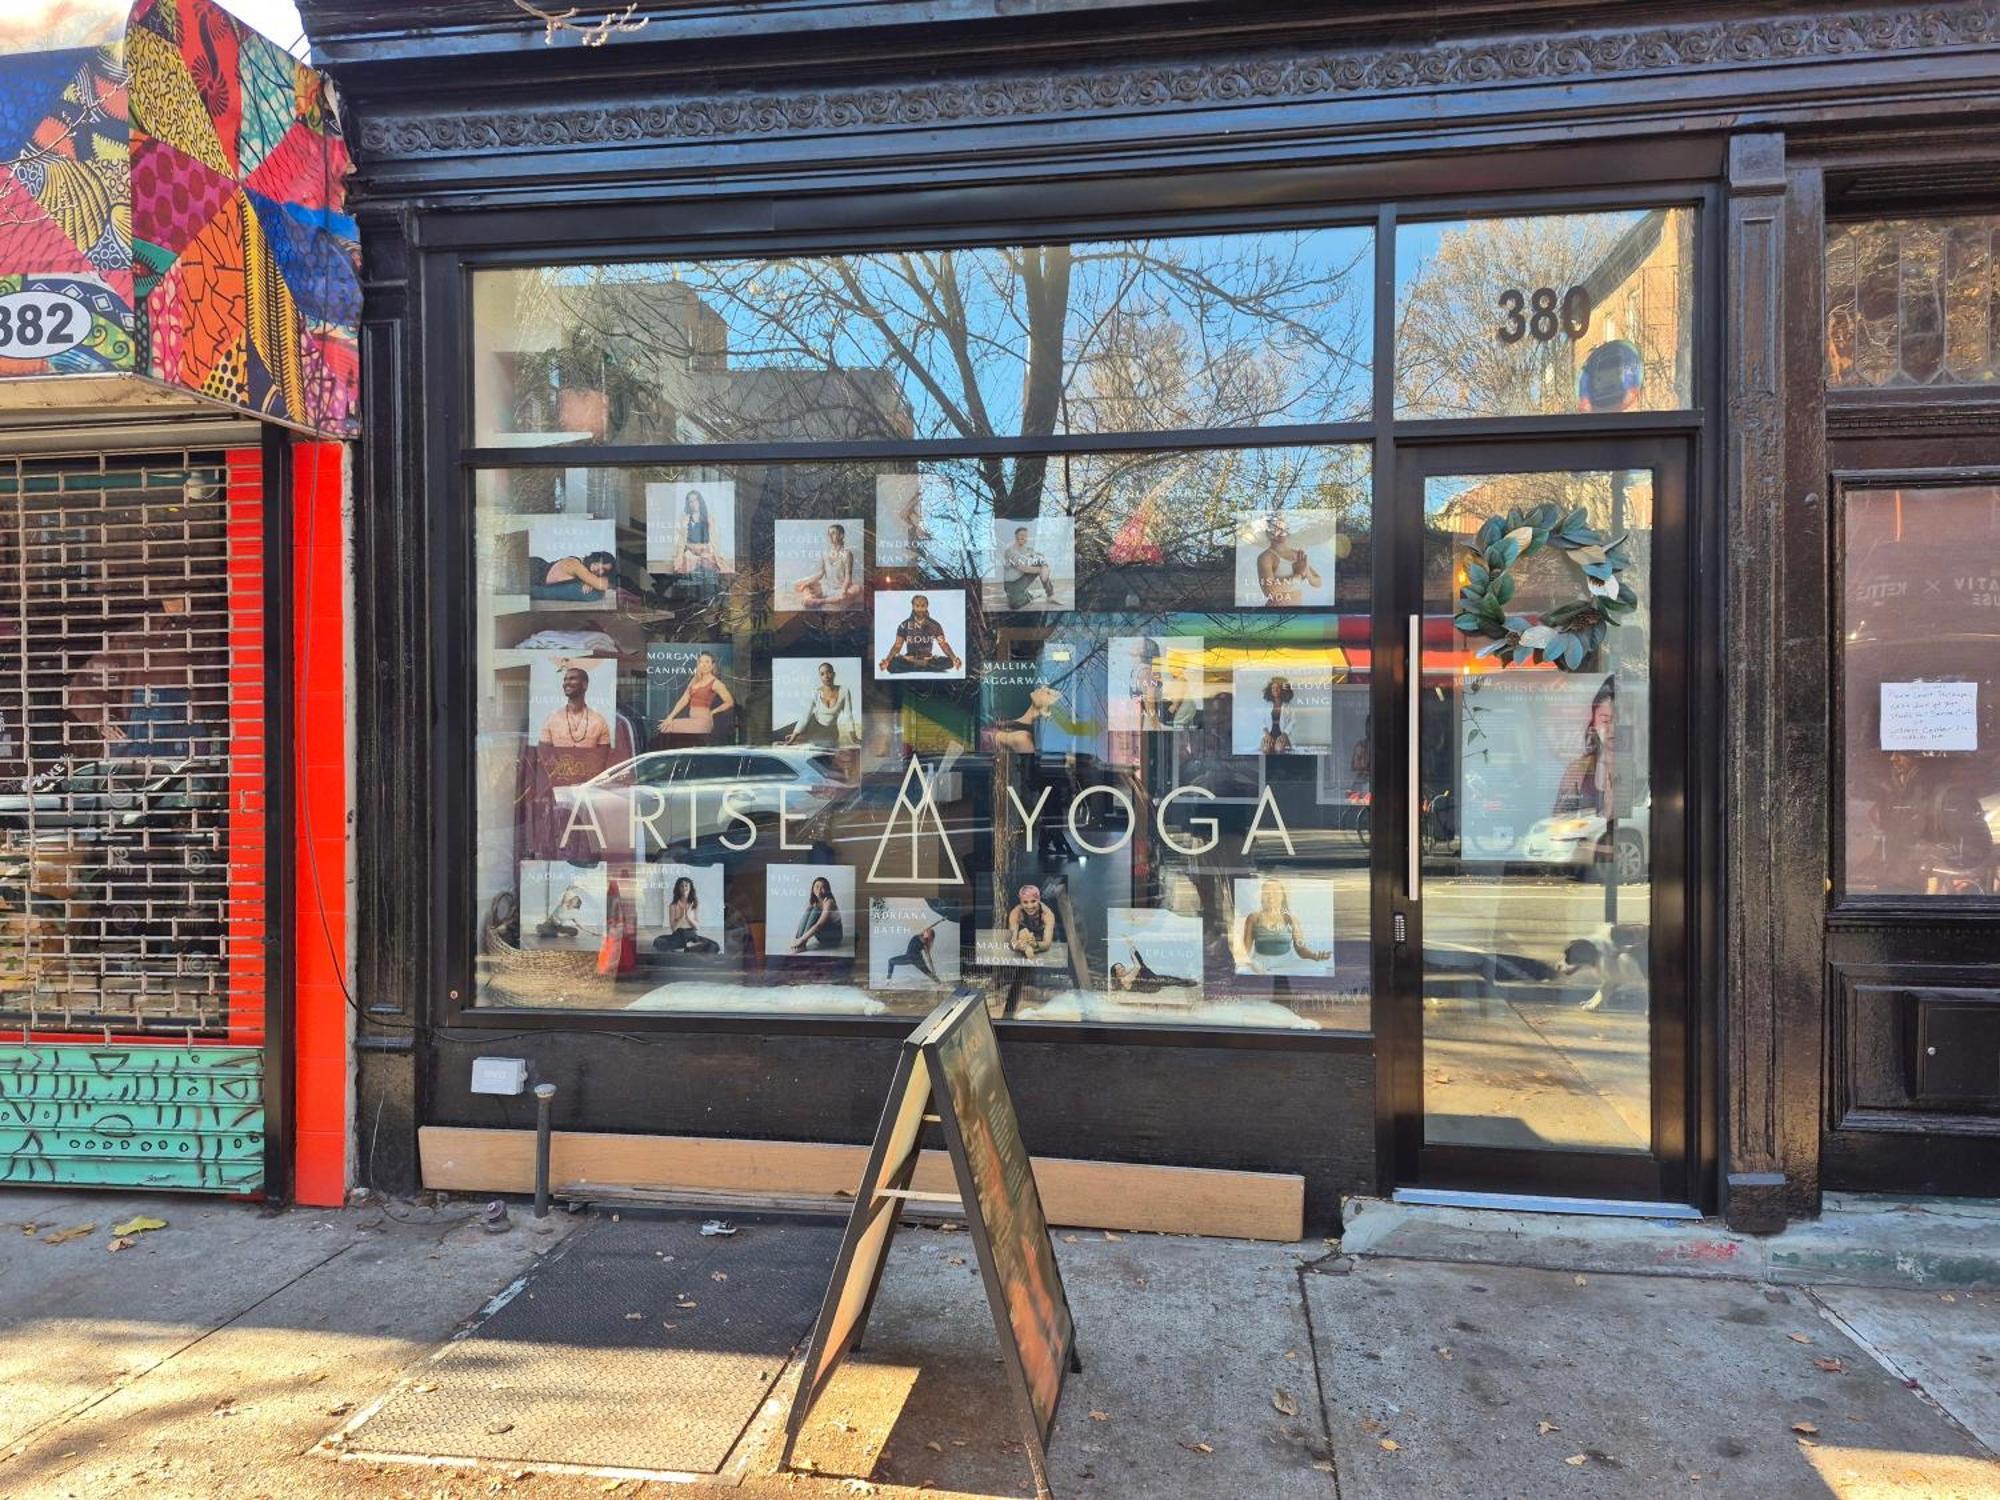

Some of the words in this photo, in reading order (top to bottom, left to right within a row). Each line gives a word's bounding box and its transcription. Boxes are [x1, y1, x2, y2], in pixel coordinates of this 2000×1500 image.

[1498, 285, 1591, 345] 380
[647, 652, 698, 661] MORGAN
[646, 666, 698, 675] CANHAM
[982, 662, 1037, 671] MALLIKA
[982, 676, 1051, 686] AGGARWAL
[1296, 696, 1331, 706] KING
[558, 785, 814, 851] ARISE
[1006, 784, 1296, 857] YOGA
[873, 911, 928, 921] ADRIANA
[976, 956, 1045, 966] BROWNING
